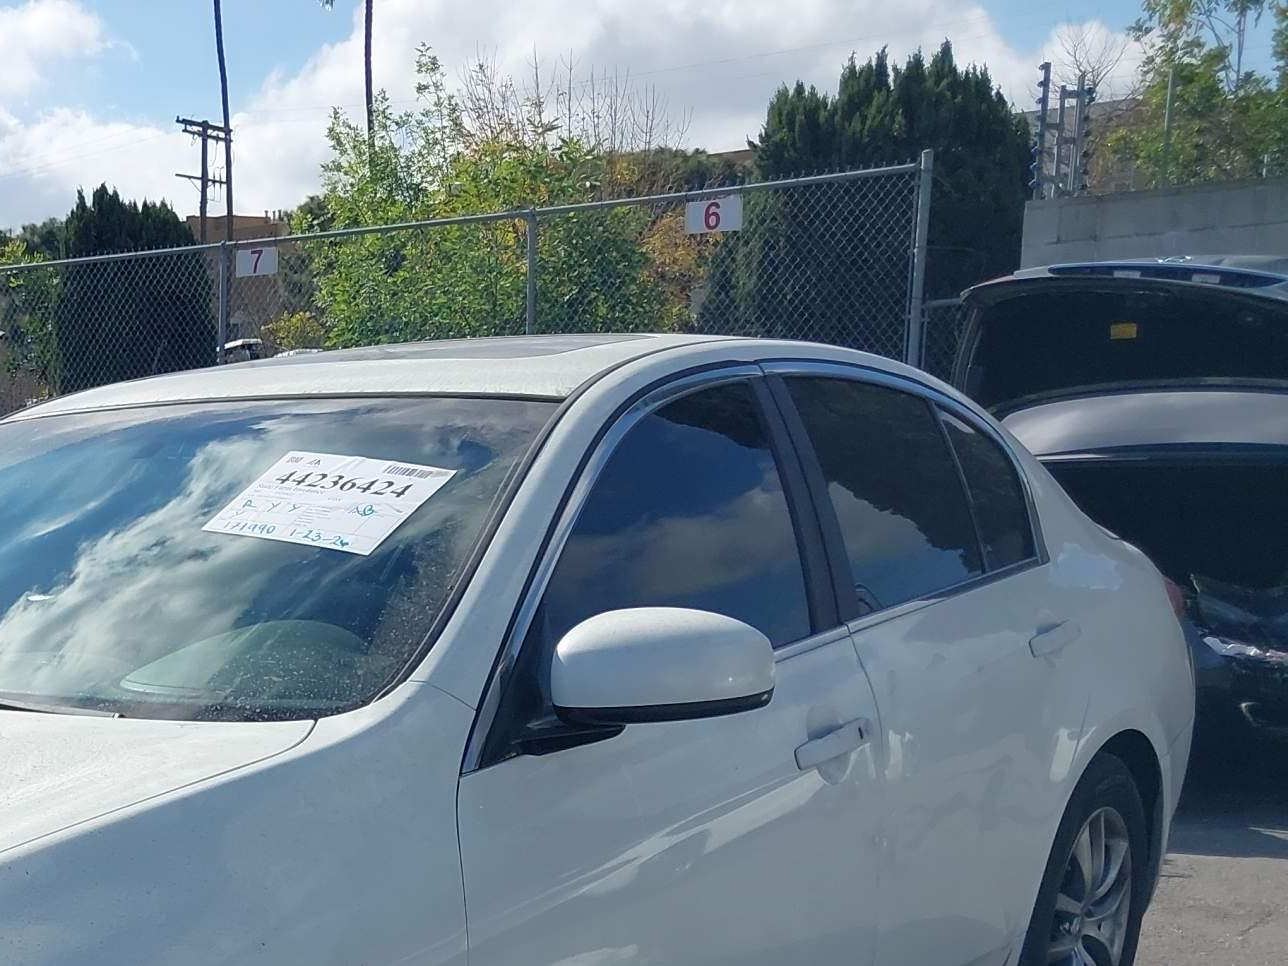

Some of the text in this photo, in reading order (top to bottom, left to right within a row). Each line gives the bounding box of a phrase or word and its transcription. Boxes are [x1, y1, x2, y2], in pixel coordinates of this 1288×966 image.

[704, 201, 721, 230] 6
[250, 249, 264, 274] 7
[275, 470, 414, 498] 44236424
